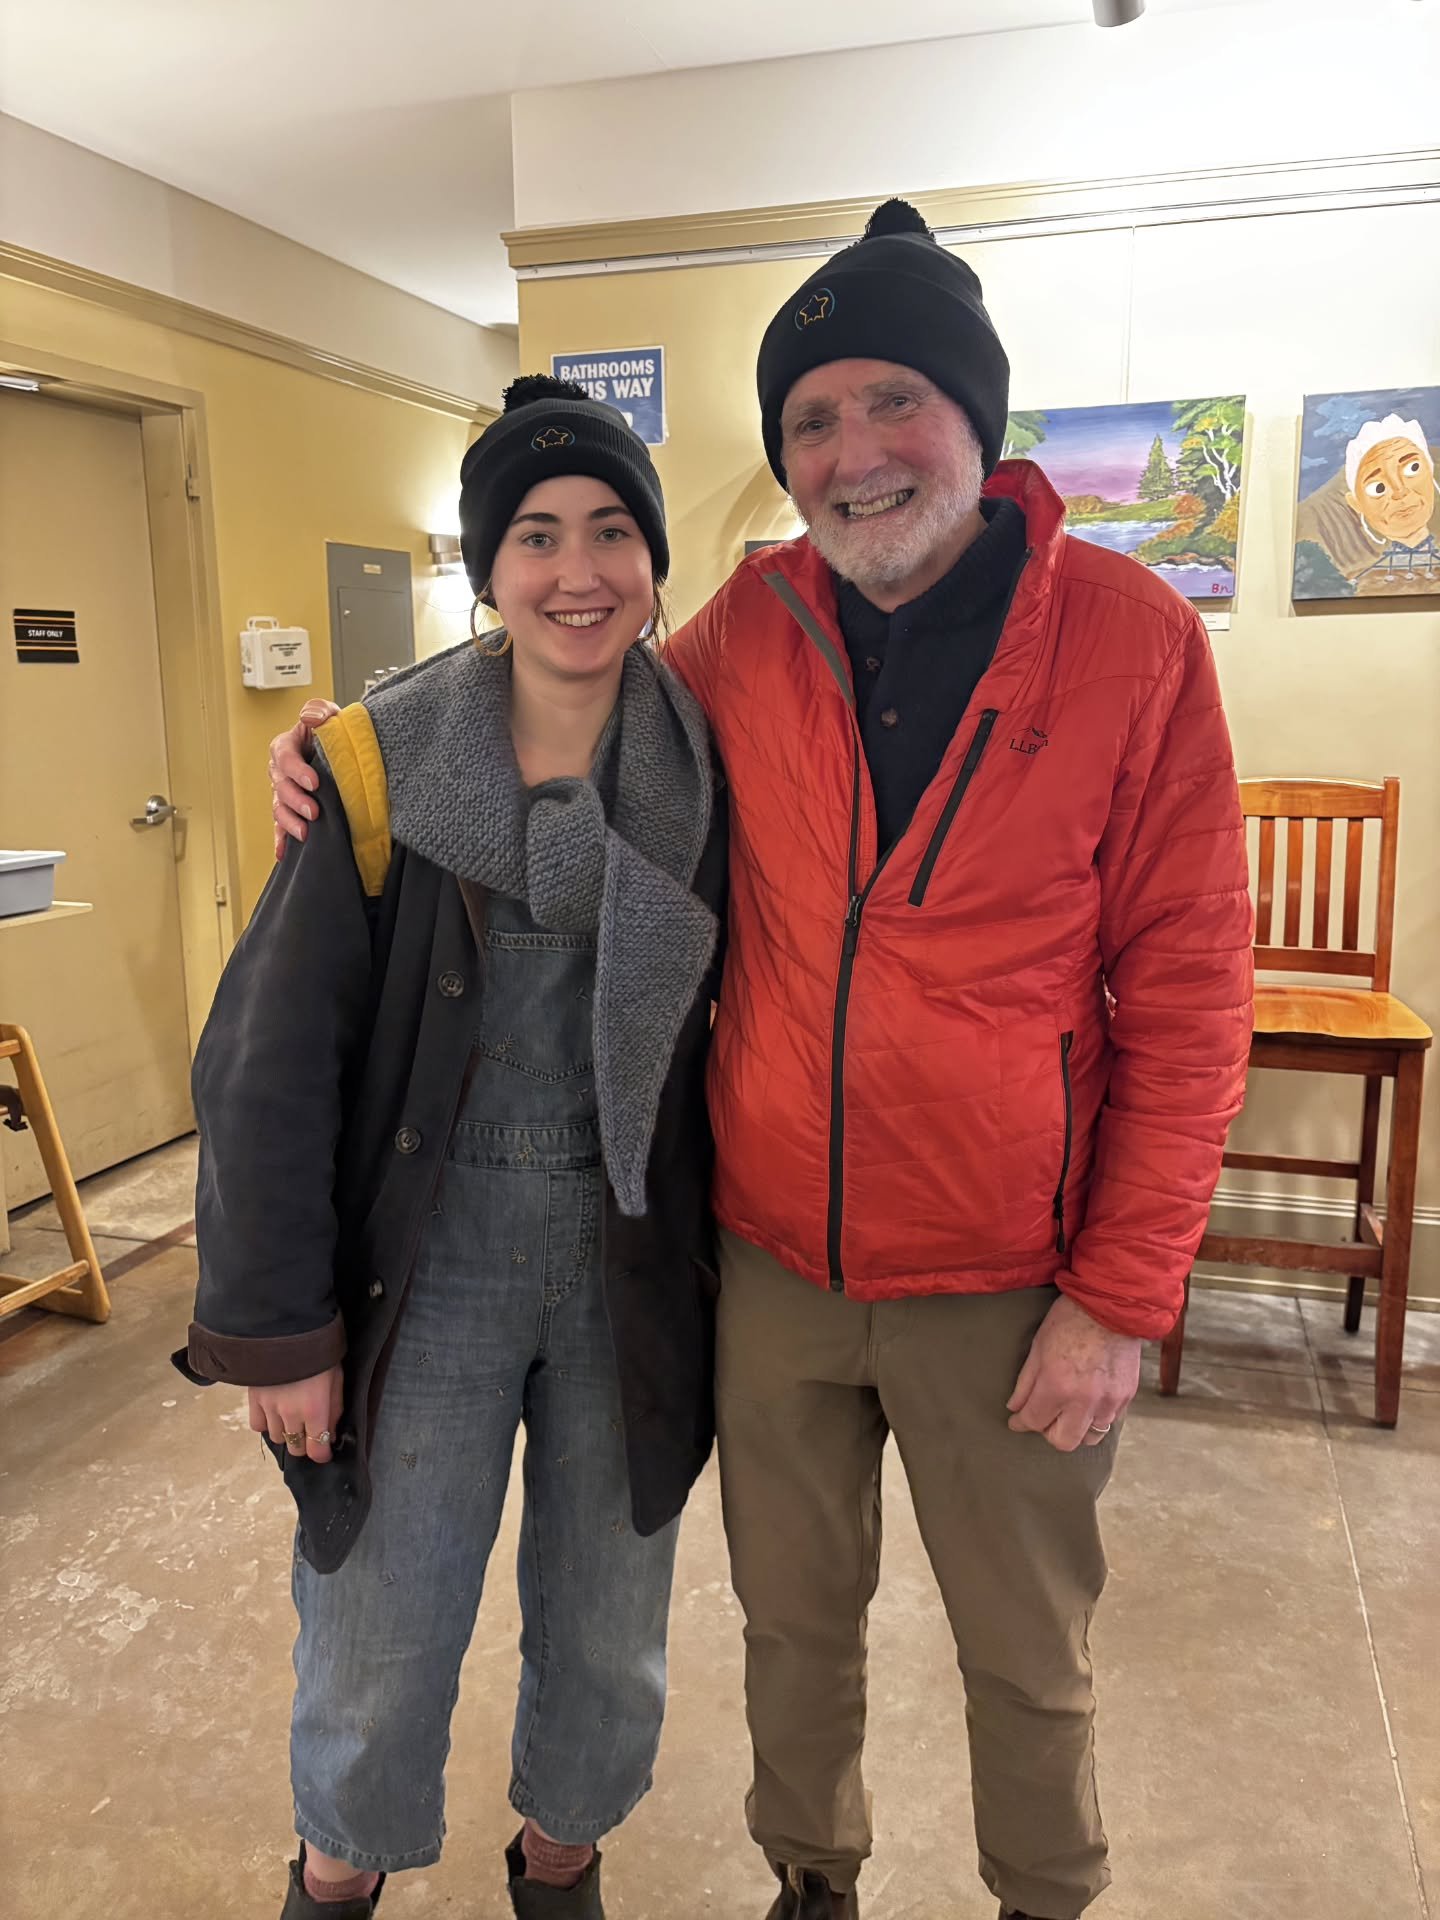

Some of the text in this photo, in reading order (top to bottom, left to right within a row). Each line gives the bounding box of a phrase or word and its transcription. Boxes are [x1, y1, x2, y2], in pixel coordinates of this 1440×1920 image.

[560, 359, 655, 381] BATHROOMS
[612, 377, 655, 399] WAY
[27, 629, 64, 638] STAFF ONLY
